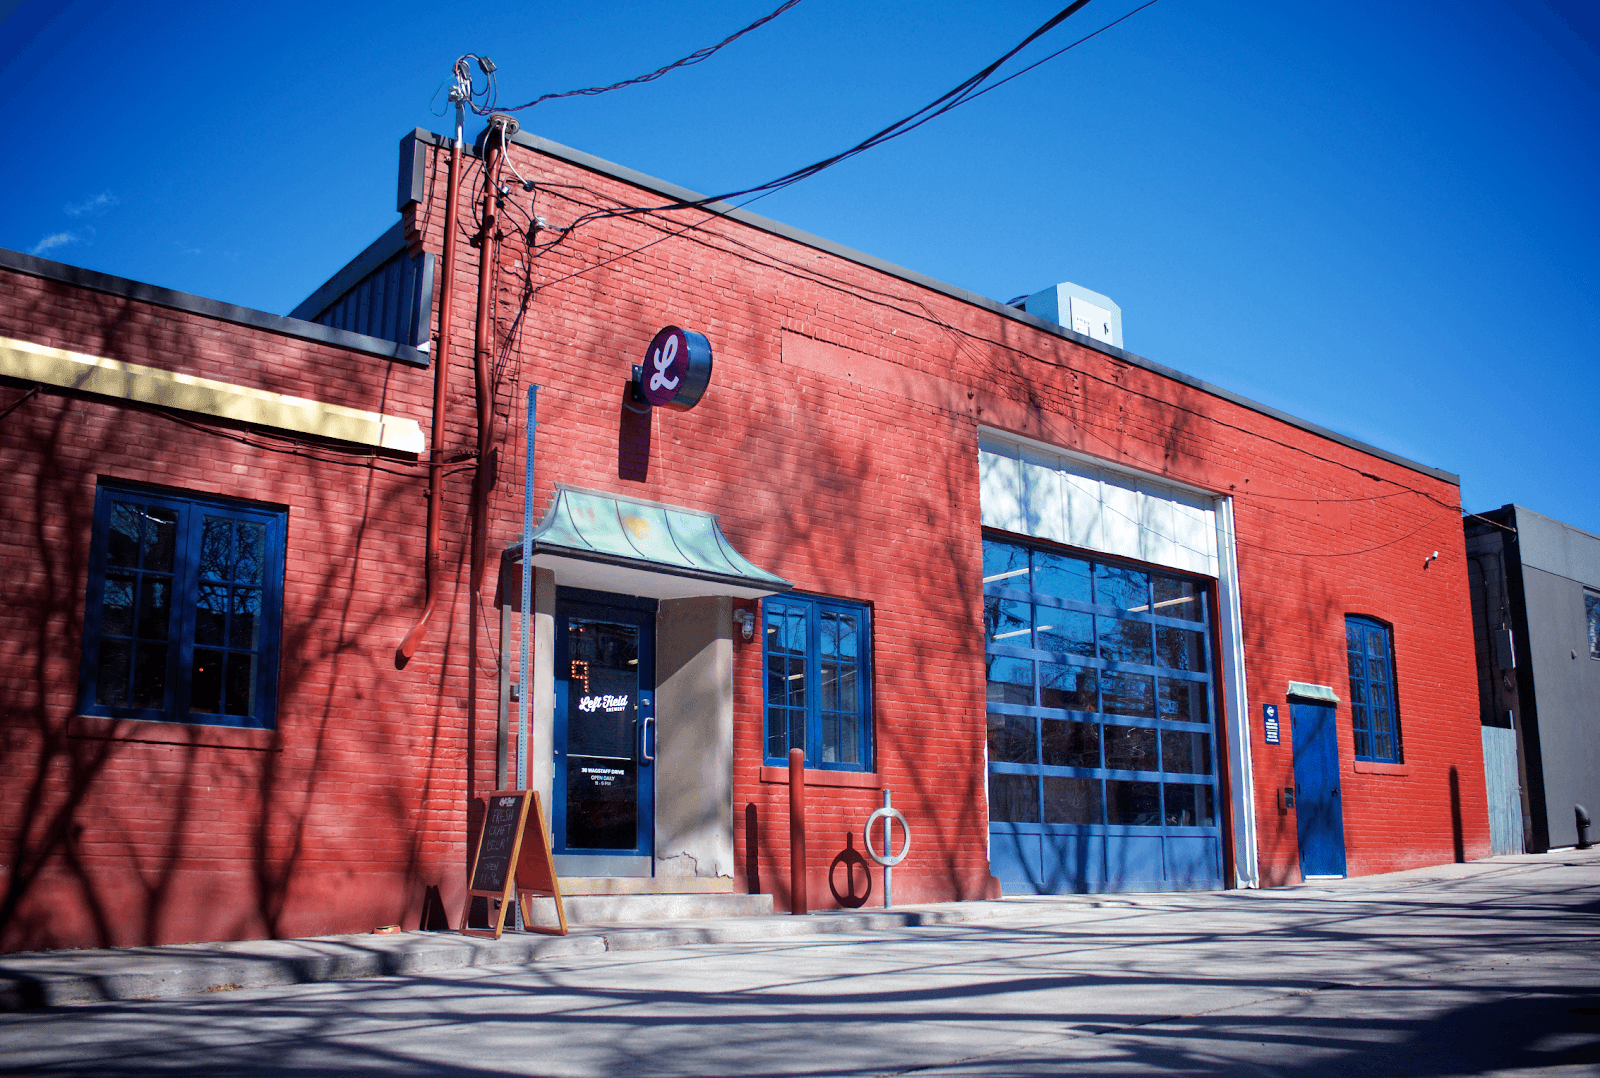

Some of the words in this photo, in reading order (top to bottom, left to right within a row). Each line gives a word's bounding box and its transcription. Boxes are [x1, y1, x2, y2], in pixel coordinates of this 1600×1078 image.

[650, 334, 680, 391] L
[579, 695, 602, 712] Left
[602, 694, 629, 709] Field
[492, 808, 515, 823] FRESH
[488, 823, 513, 837] CRAFT
